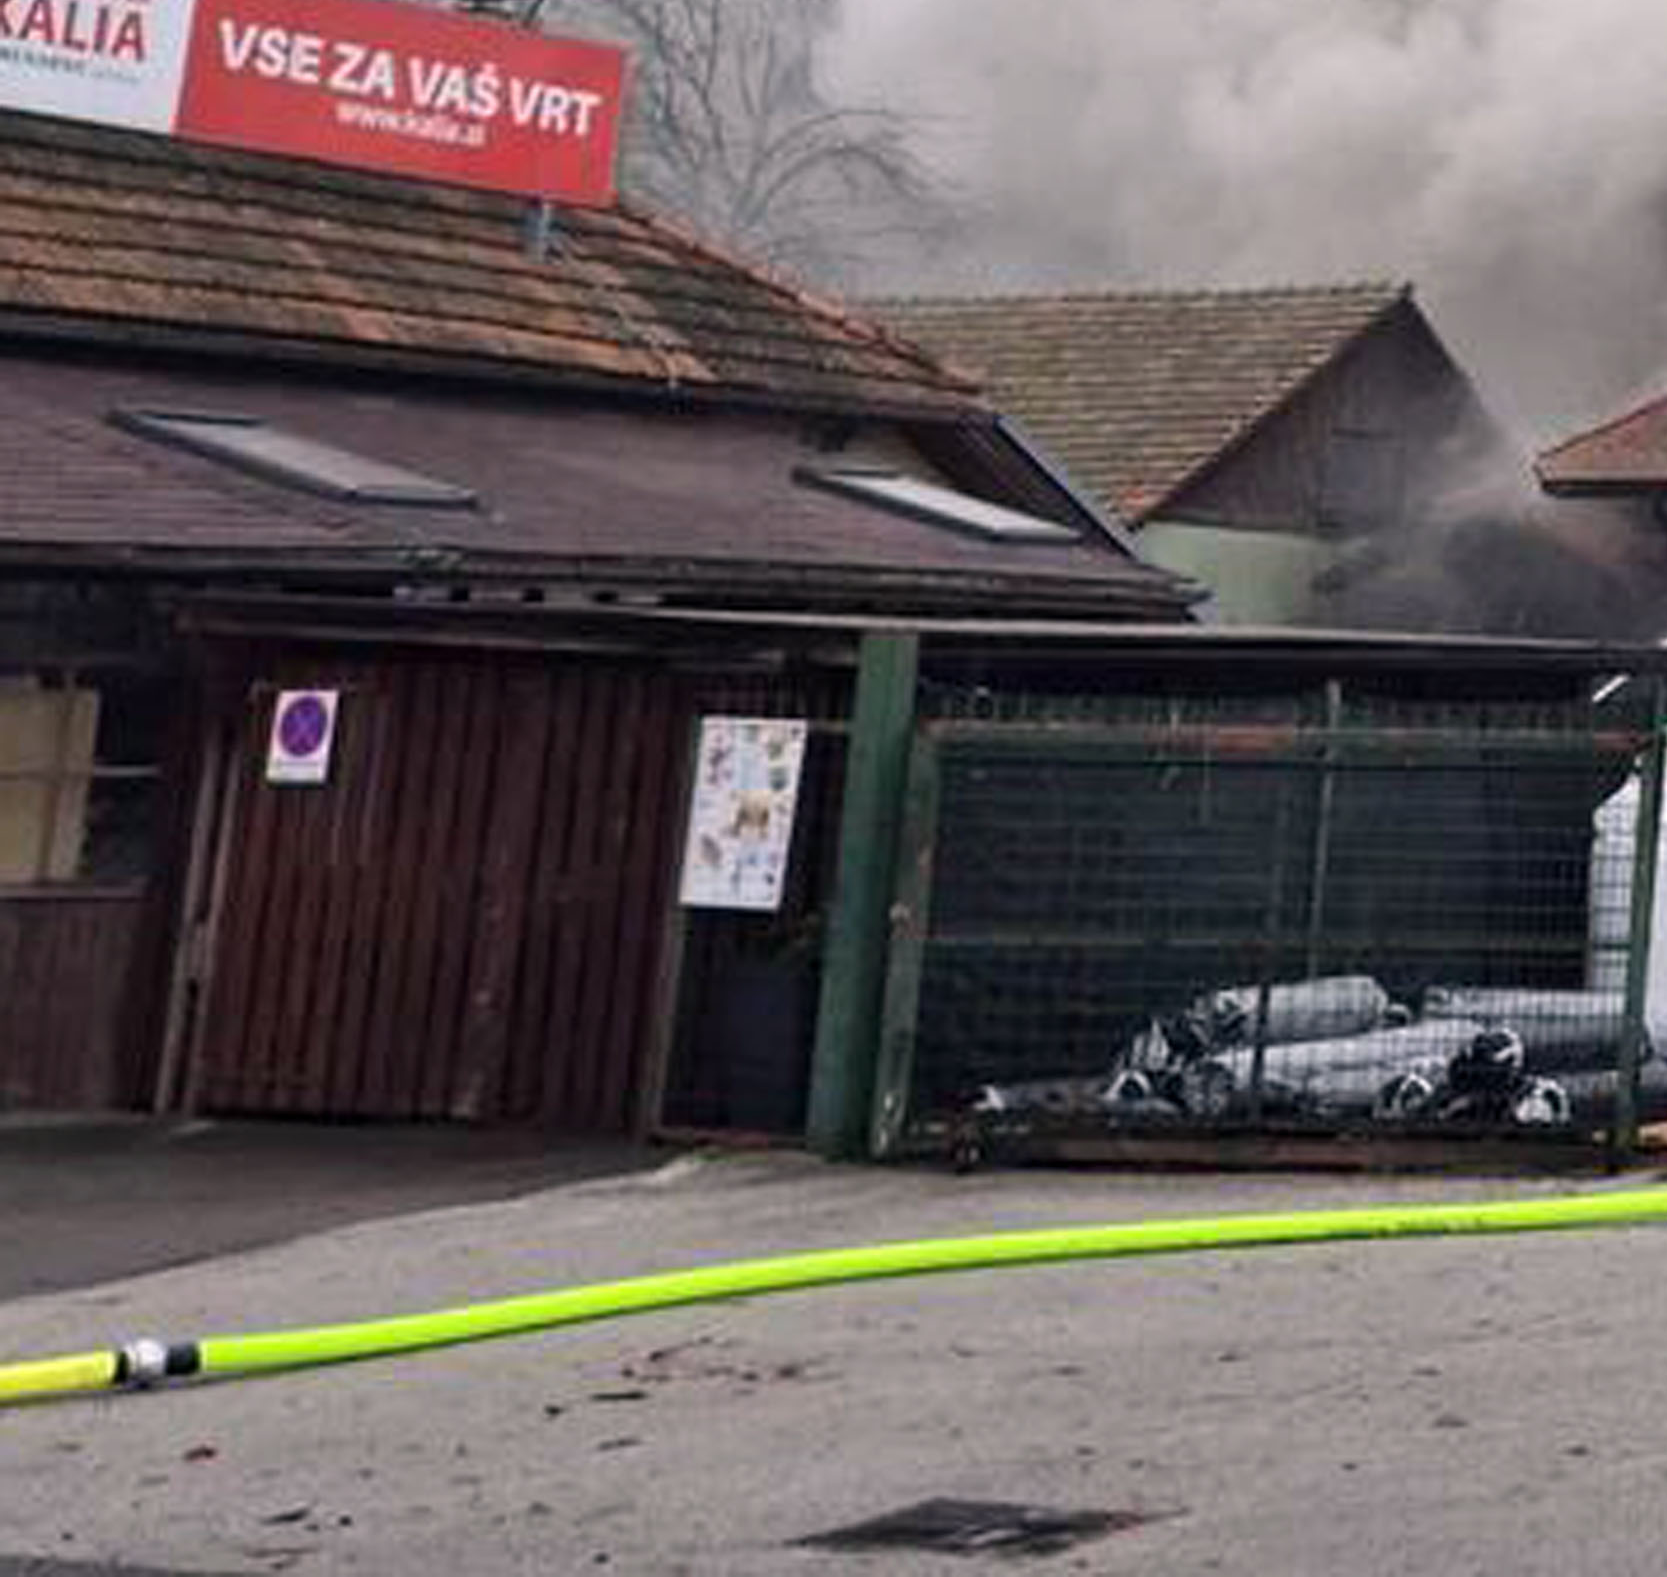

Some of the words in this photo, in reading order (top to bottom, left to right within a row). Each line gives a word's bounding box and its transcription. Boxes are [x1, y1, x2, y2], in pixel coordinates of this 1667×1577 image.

[219, 18, 323, 84] VSE
[329, 40, 397, 100] ZA
[408, 56, 500, 119] VAŠ
[509, 77, 602, 137] VRT
